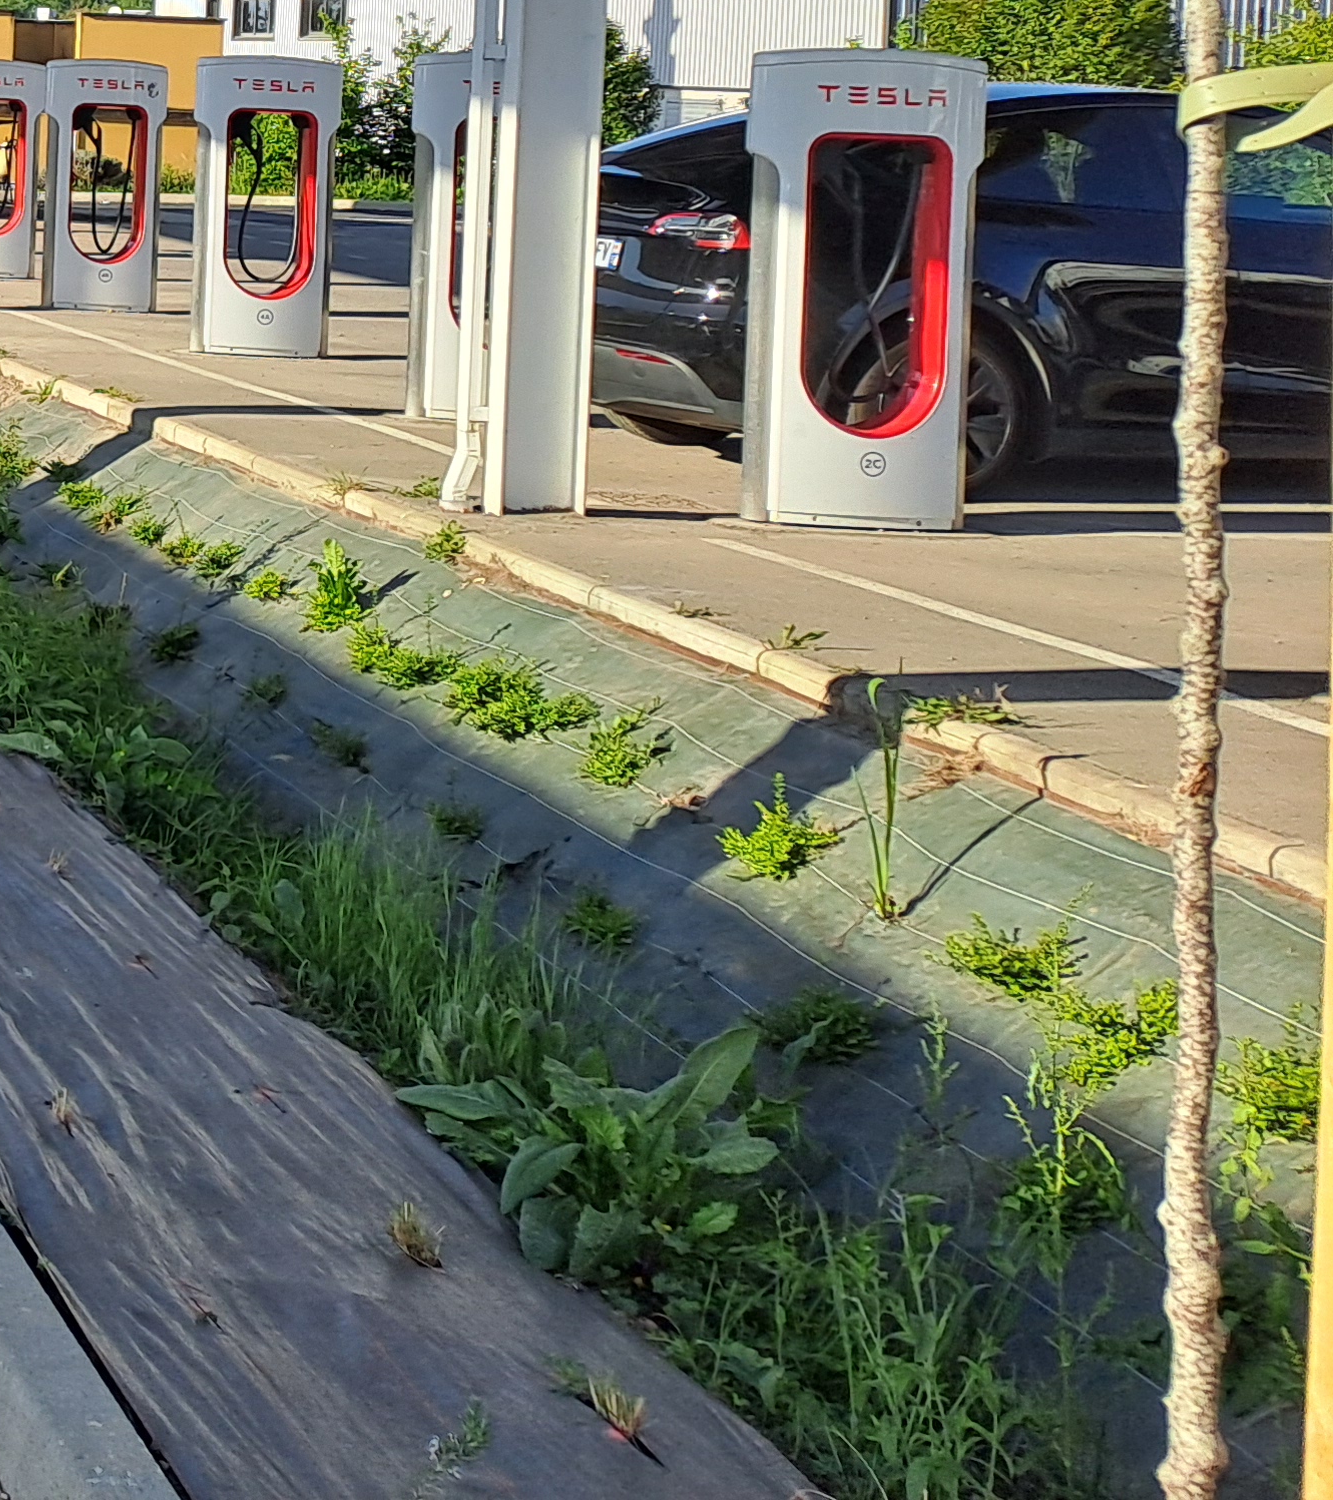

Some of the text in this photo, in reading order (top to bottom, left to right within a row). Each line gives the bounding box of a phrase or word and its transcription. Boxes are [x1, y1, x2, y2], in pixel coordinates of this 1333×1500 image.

[77, 78, 145, 90] TESLA
[232, 78, 315, 93] TESLA
[817, 85, 948, 107] TESLA
[864, 459, 882, 469] 2C
